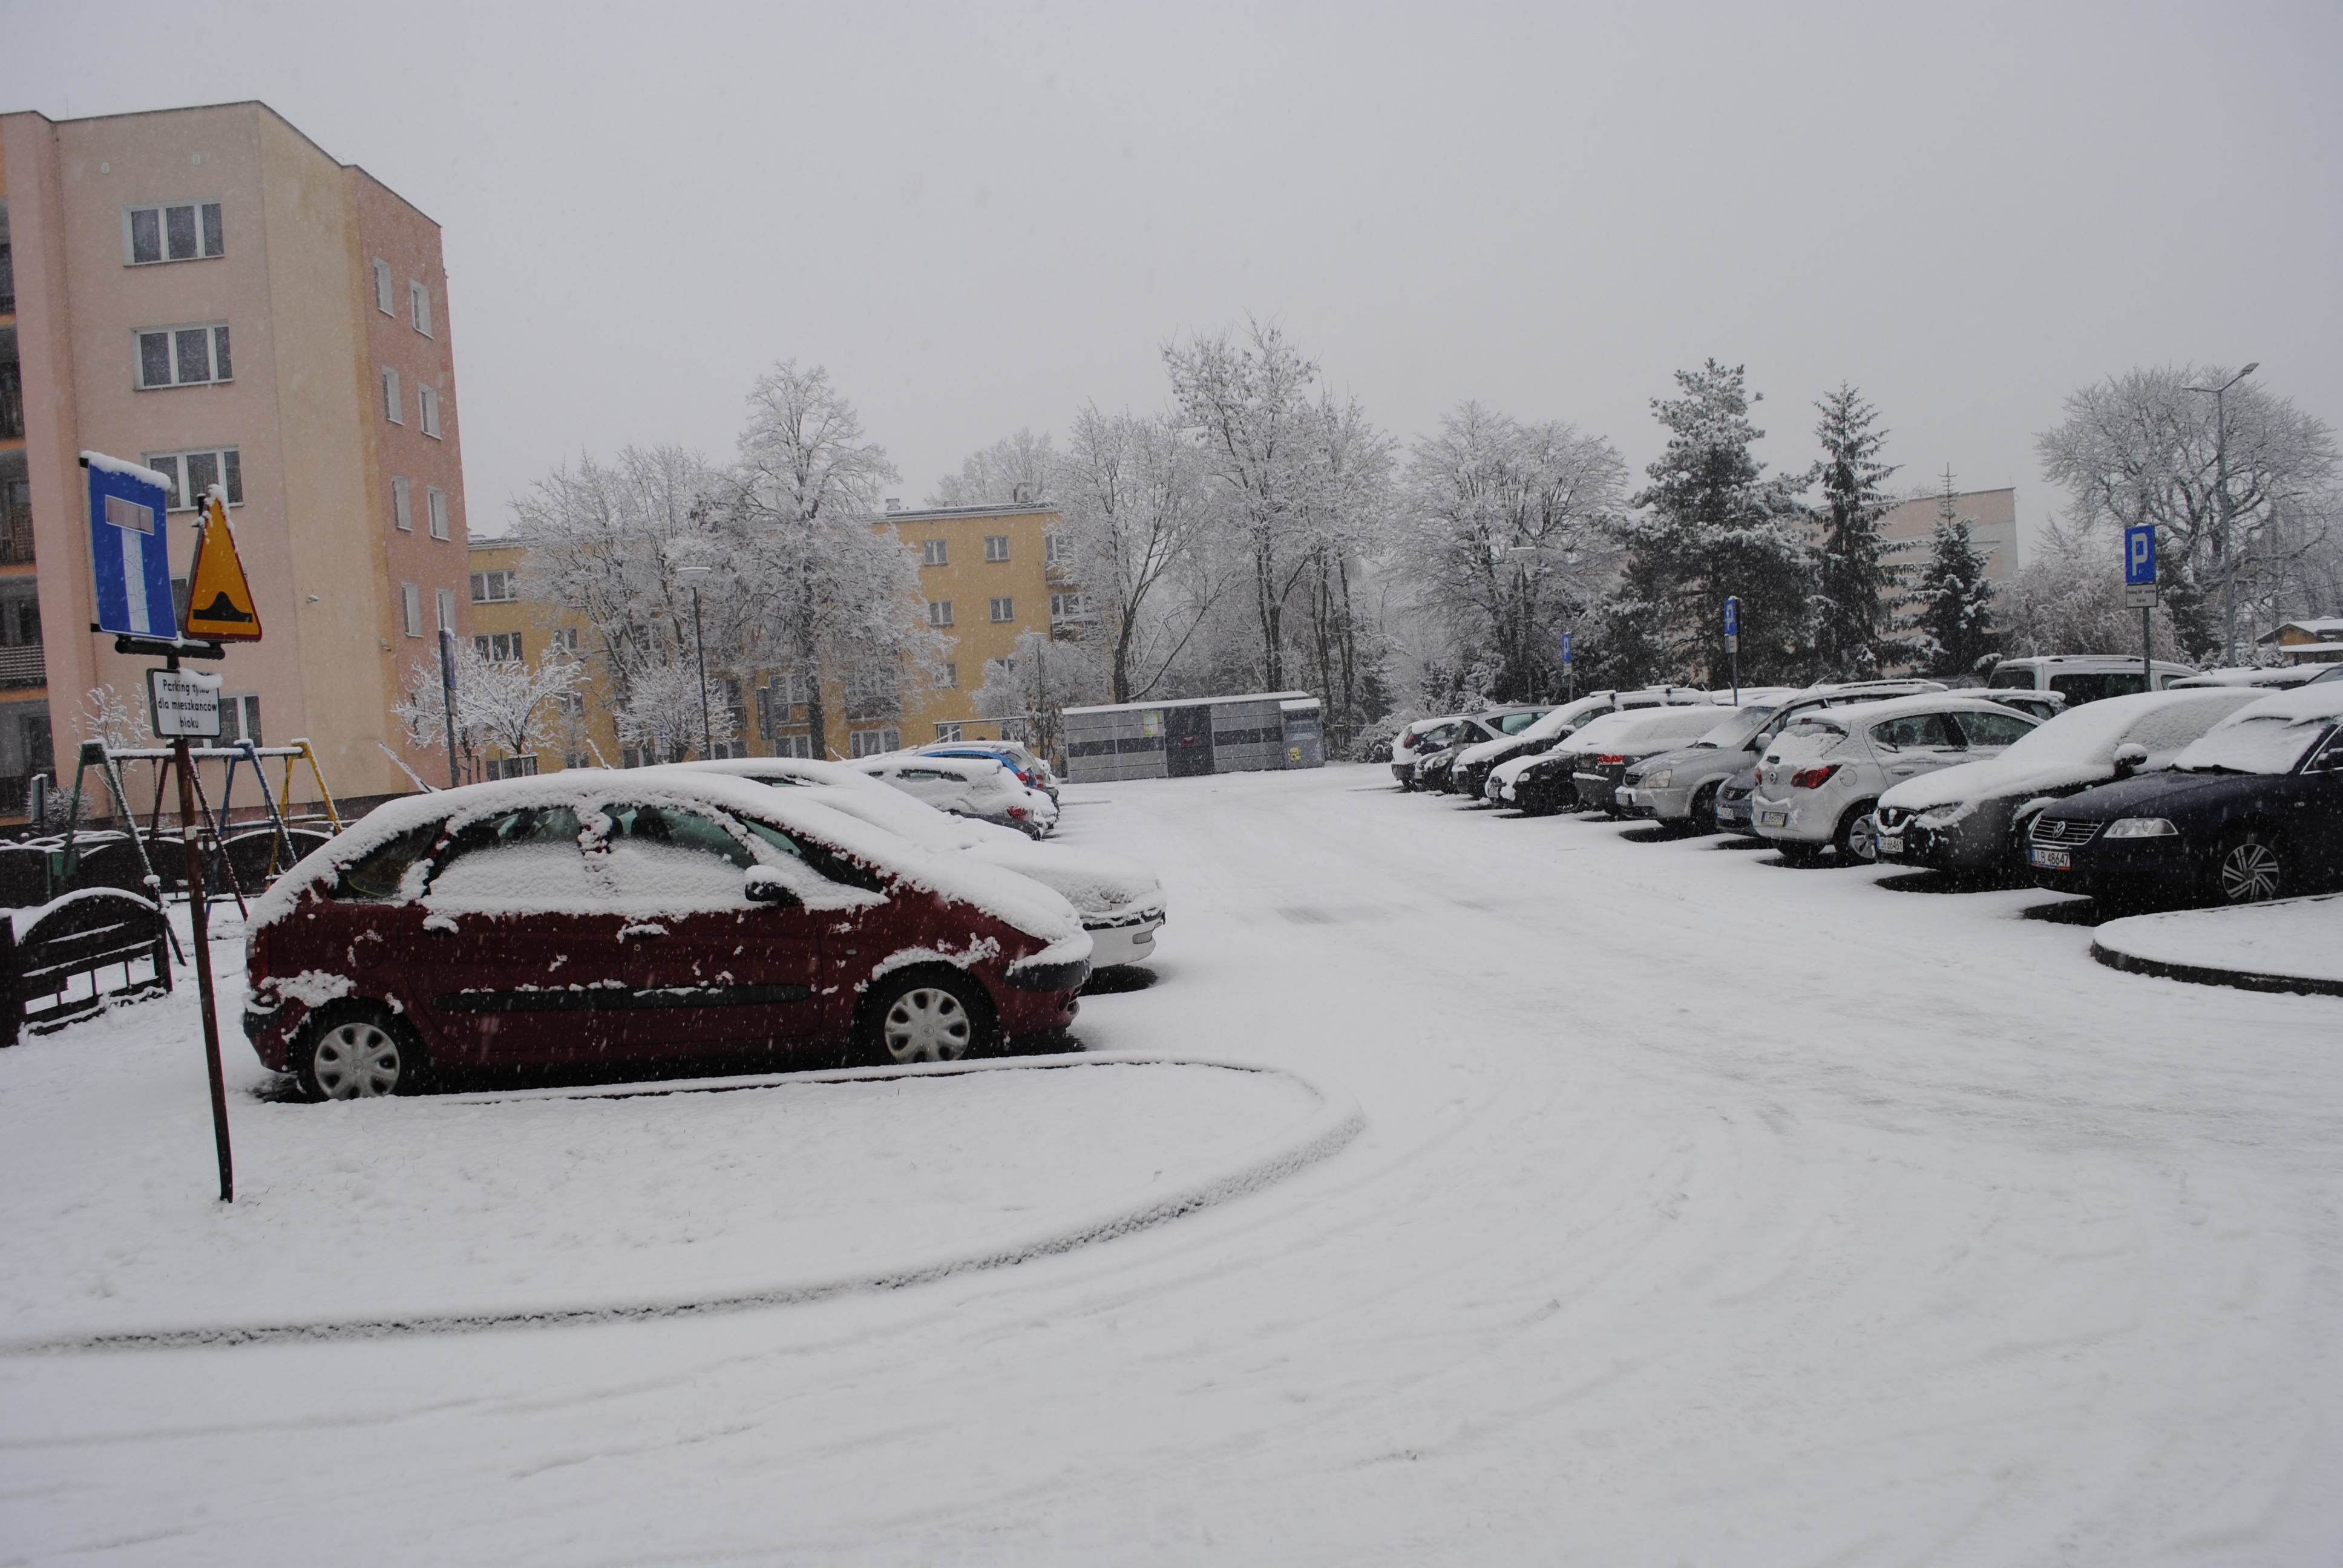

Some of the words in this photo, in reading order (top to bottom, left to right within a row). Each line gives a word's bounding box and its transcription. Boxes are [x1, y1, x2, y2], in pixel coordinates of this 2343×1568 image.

[2131, 532, 2148, 576] P
[1726, 604, 1733, 631] P
[163, 679, 189, 696] Parking
[158, 697, 169, 709] dla
[172, 698, 217, 711] mieszkańców
[179, 716, 199, 728] bloku
[2047, 851, 2069, 866] 48647
